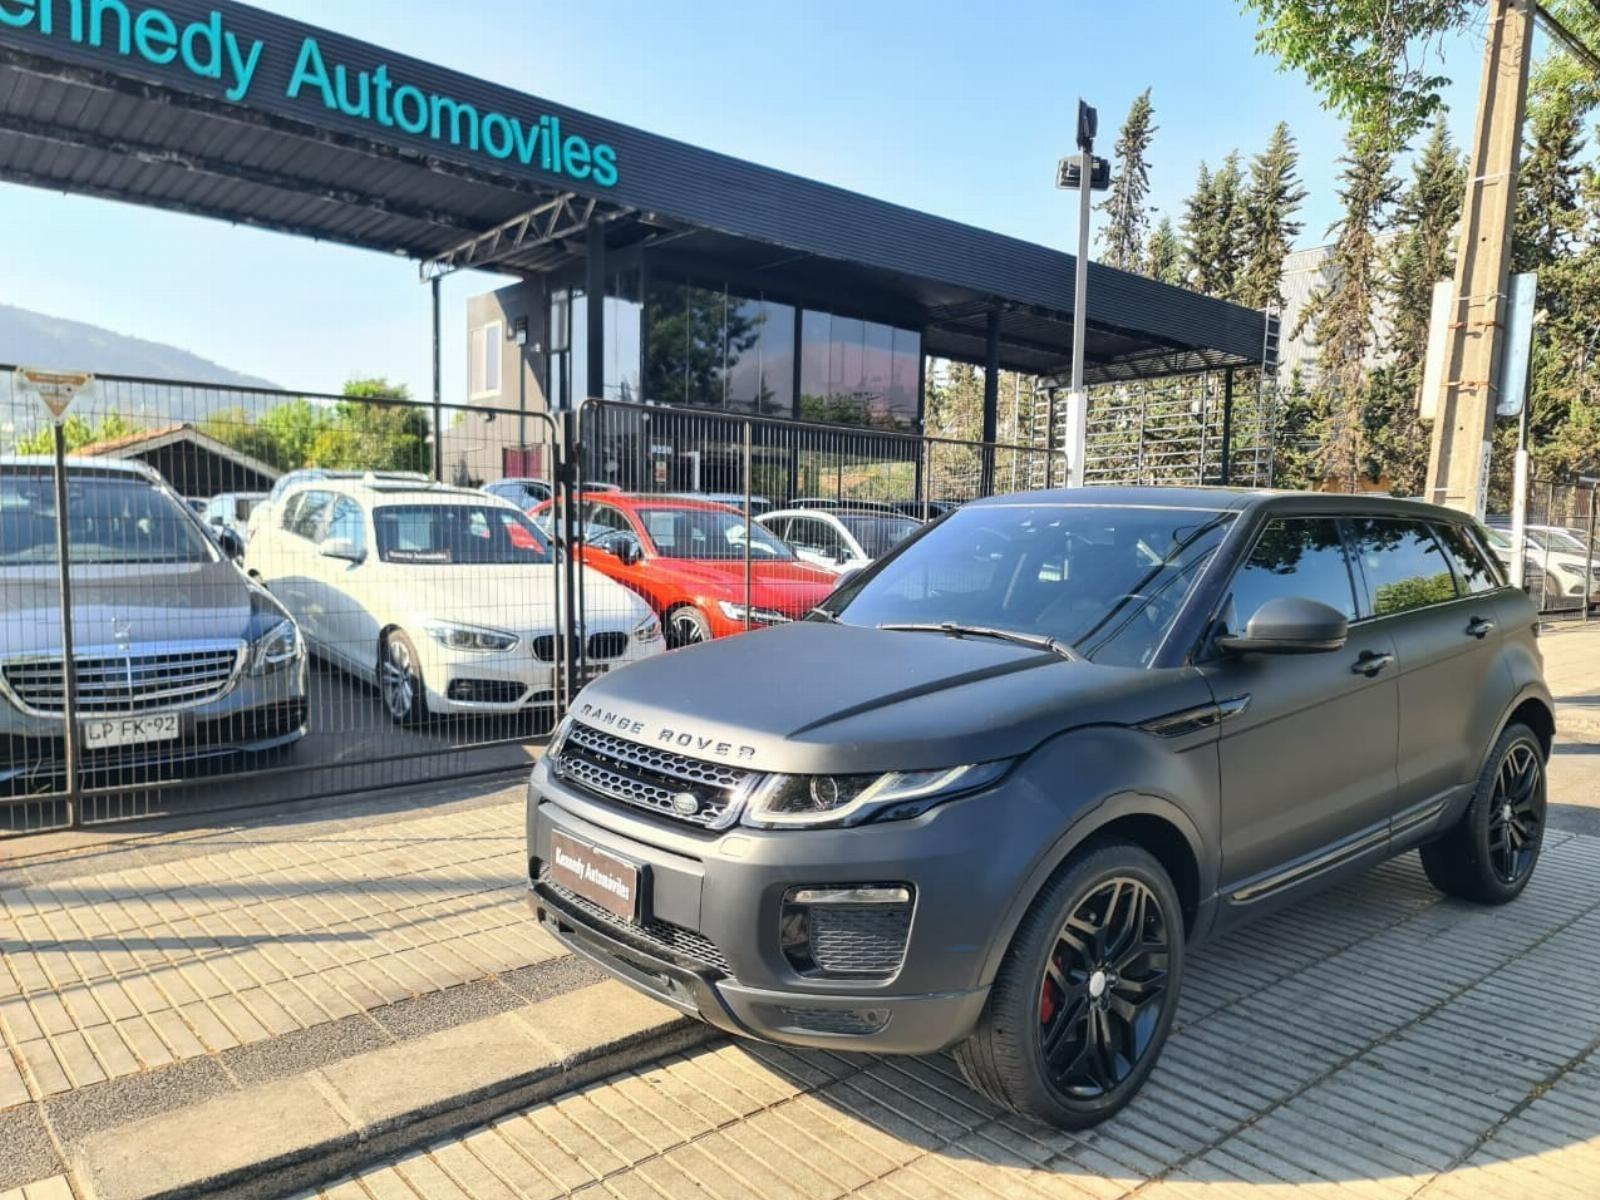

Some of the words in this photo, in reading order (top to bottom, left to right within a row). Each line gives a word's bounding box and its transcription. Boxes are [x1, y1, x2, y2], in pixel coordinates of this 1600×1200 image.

[286, 37, 619, 187] Automoviles
[580, 703, 645, 735] RANGE
[658, 728, 756, 761] ROVER
[555, 846, 585, 880] Kennedy
